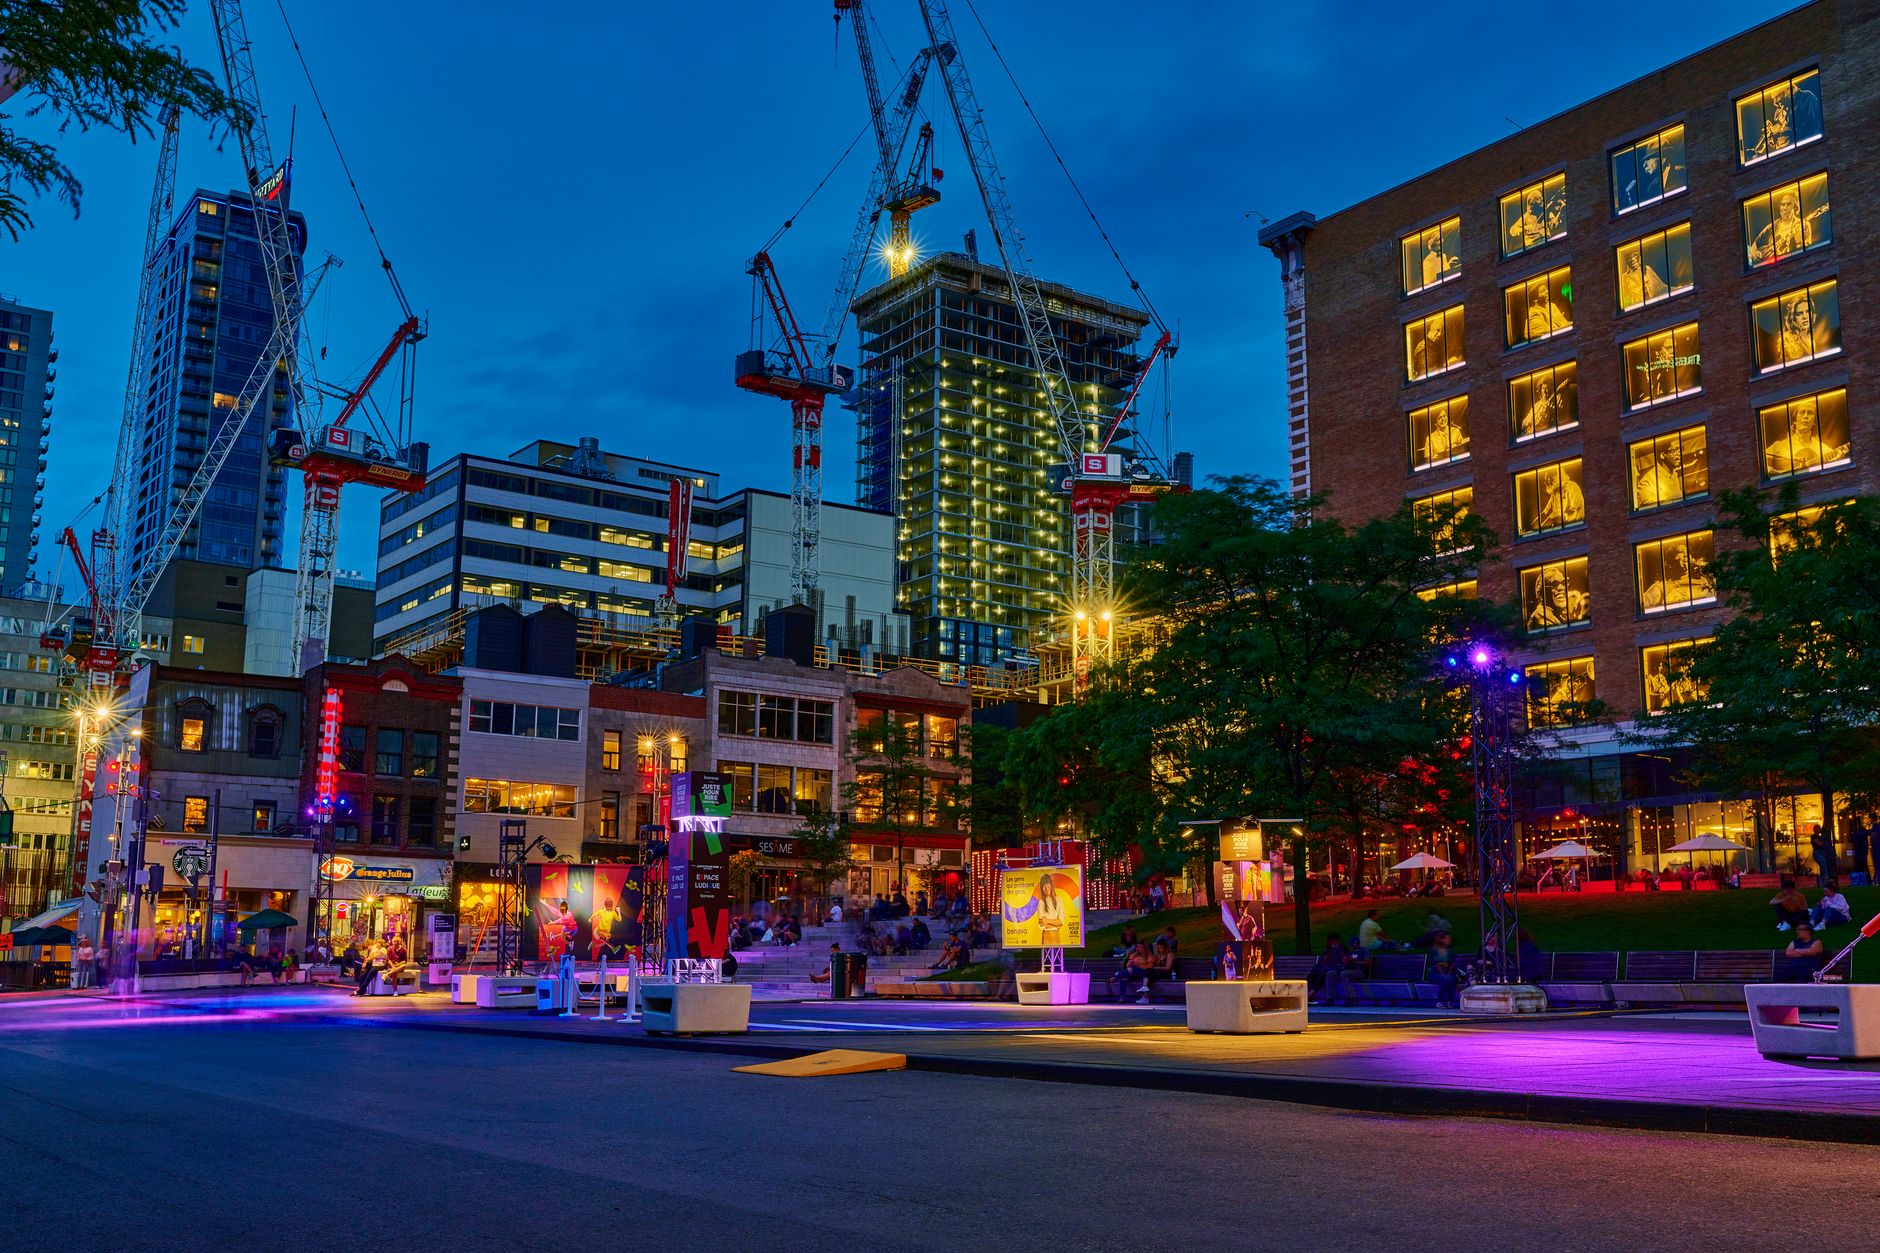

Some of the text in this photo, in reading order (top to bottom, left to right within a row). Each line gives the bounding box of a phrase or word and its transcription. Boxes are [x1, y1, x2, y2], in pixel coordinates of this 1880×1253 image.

[807, 412, 819, 424] A
[332, 432, 344, 442] S
[1088, 459, 1102, 470] S
[370, 466, 408, 479] SYNERGY
[315, 487, 338, 505] C
[1094, 512, 1110, 529] D
[92, 671, 111, 686] B
[356, 868, 412, 878] Orange Julius
